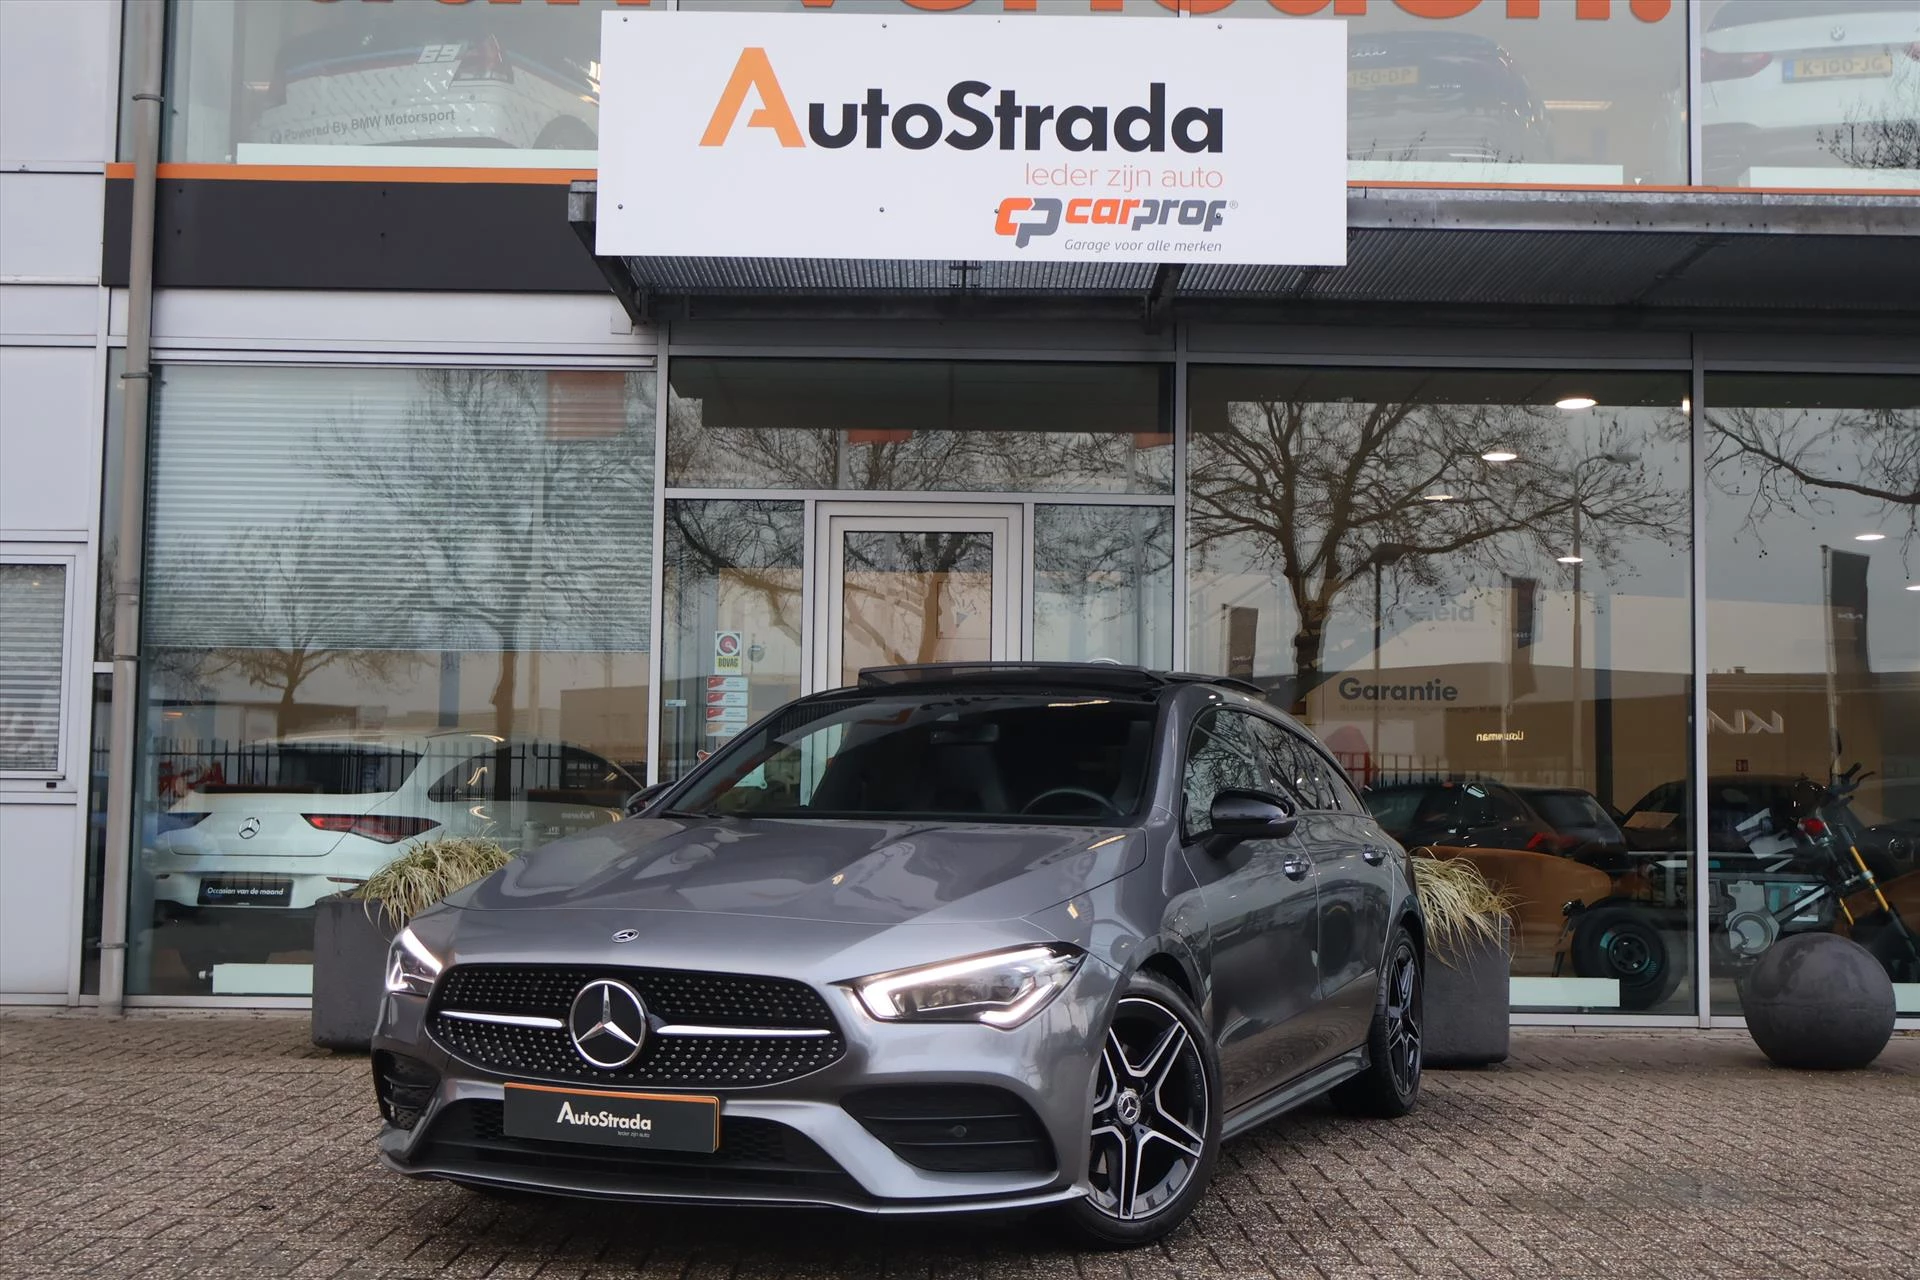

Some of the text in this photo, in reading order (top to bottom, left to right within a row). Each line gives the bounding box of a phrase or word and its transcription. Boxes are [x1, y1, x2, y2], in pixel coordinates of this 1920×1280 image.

[416, 44, 462, 64] 69
[698, 47, 1224, 153] AutoStrada
[284, 109, 457, 141] Powered By BMW Motorsport
[1025, 163, 1223, 193] Ieder zijn auto
[1064, 239, 1222, 254] Garage voor alle merken
[1338, 677, 1458, 702] Garantie
[207, 887, 236, 895] Occasion
[250, 887, 259, 895] de
[260, 887, 284, 895] maand
[556, 1101, 652, 1130] AutoStrada
